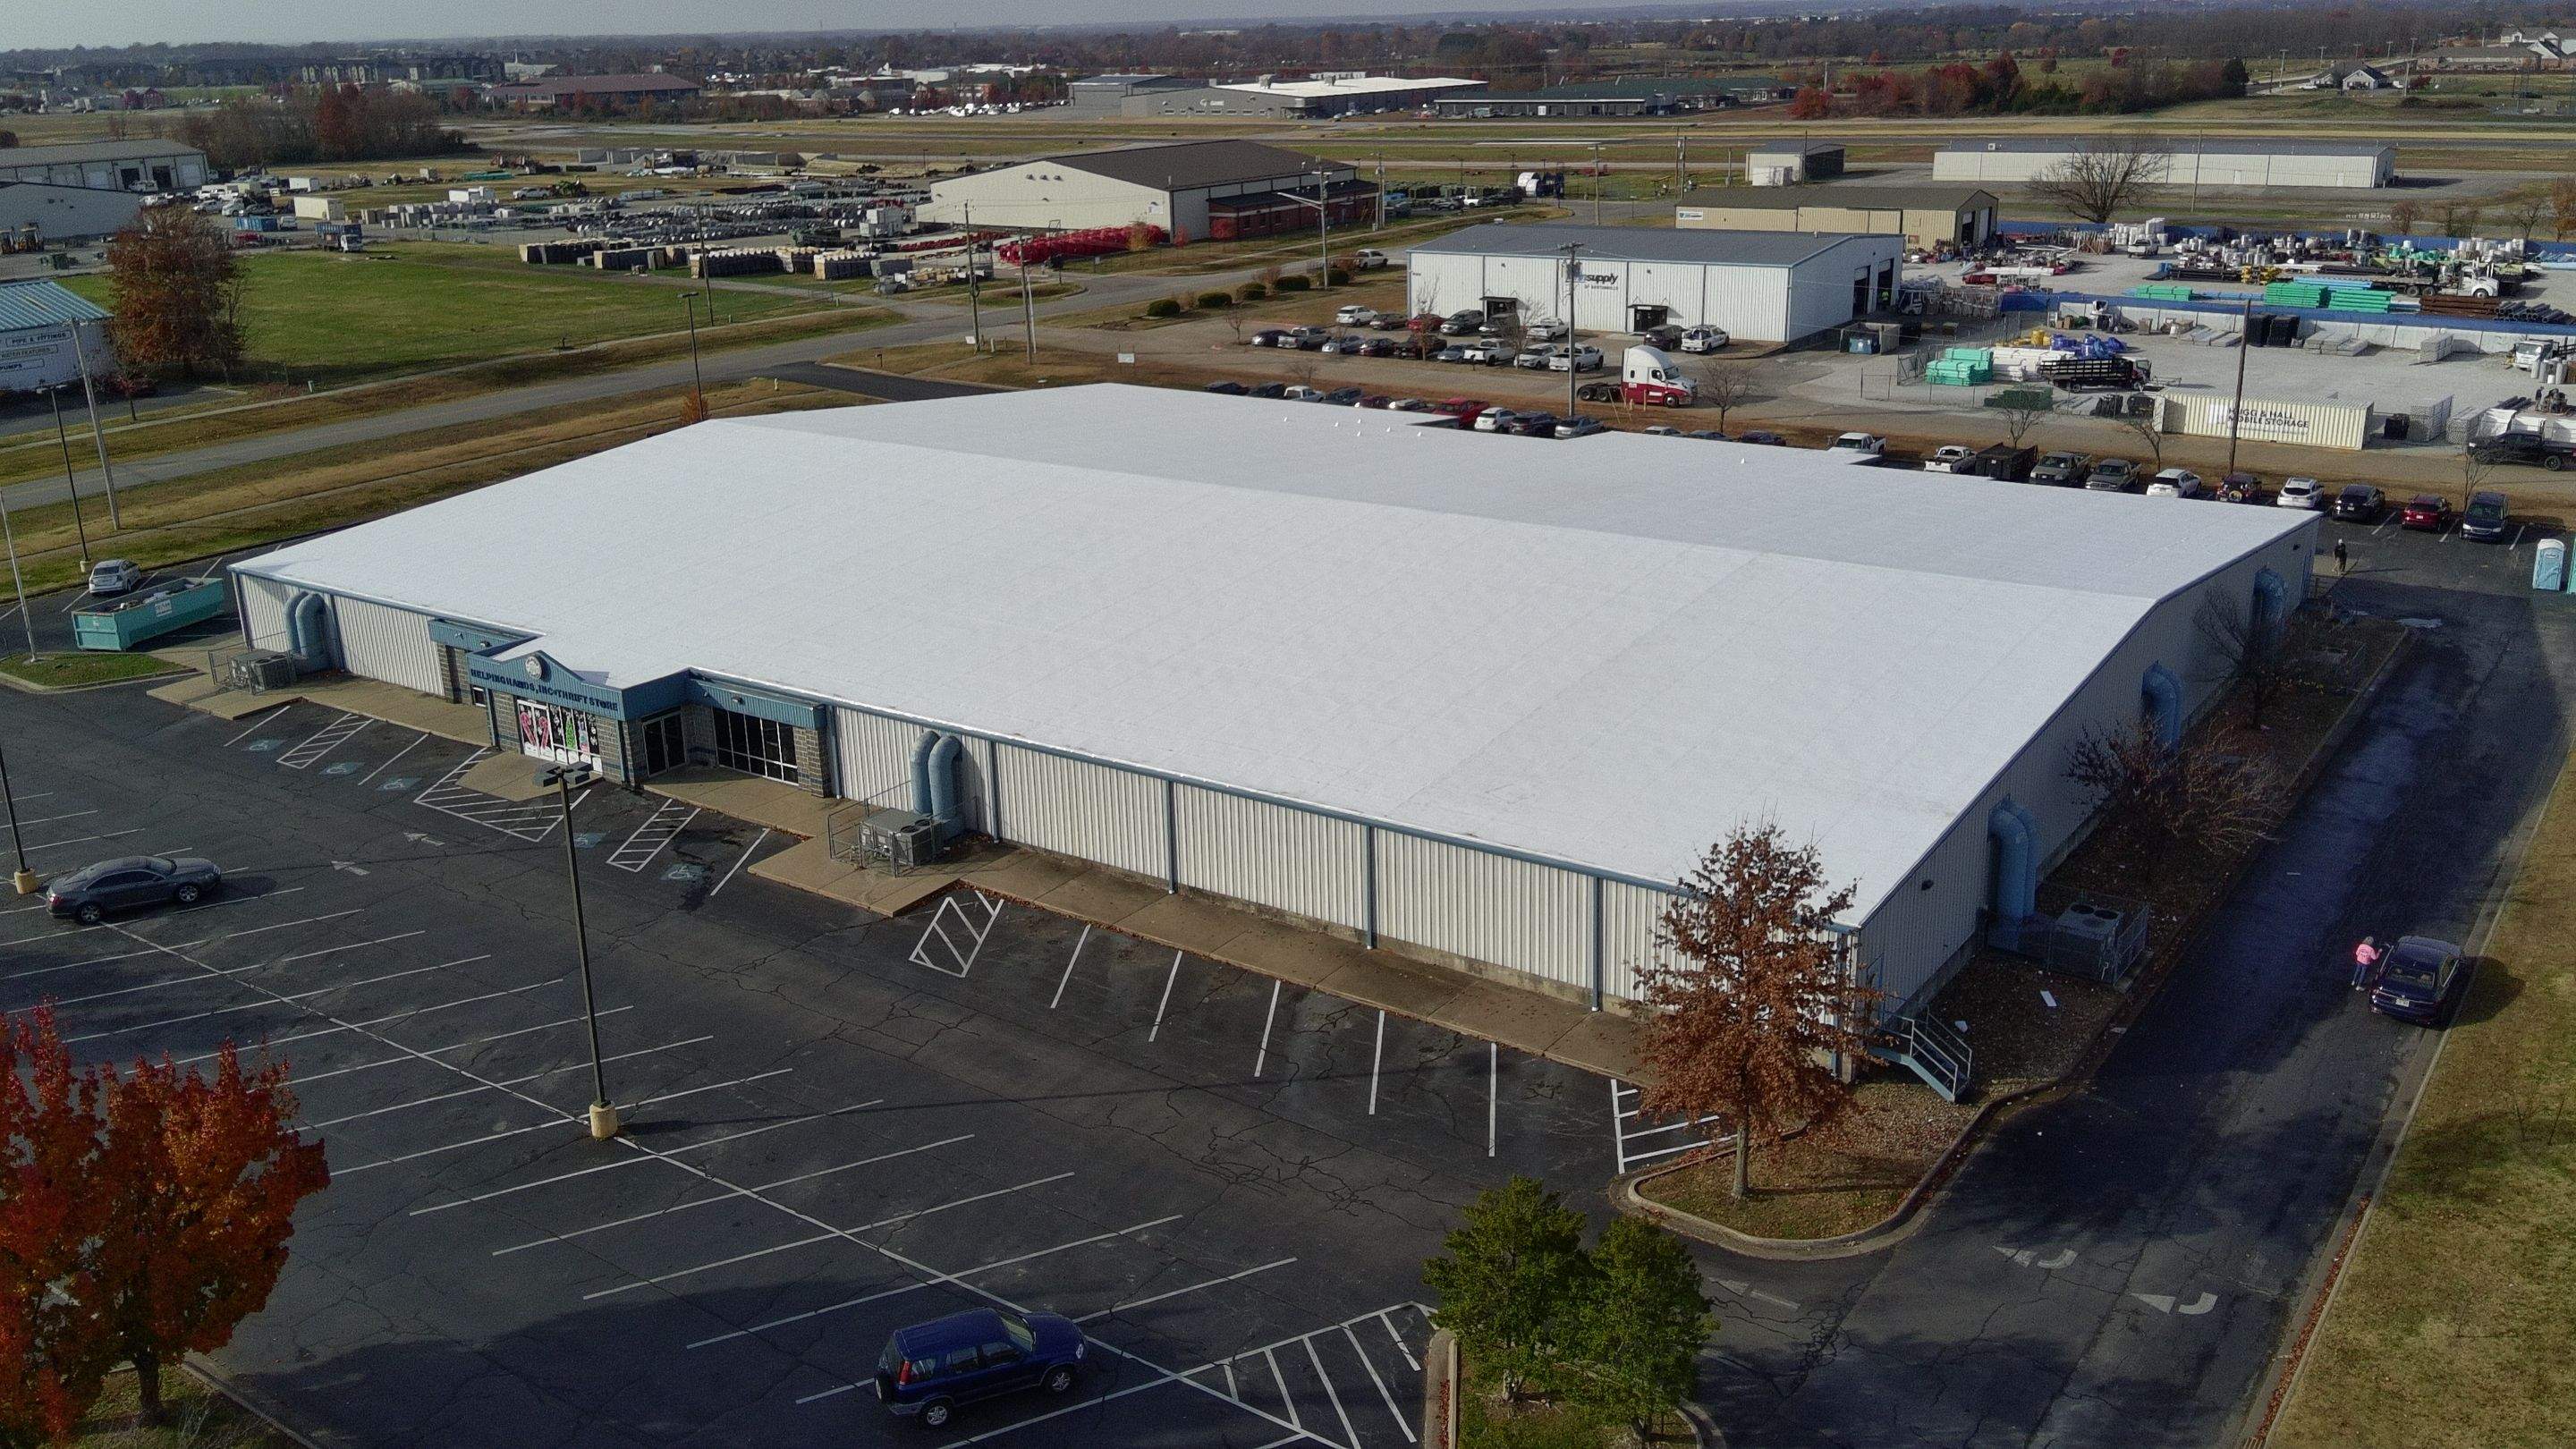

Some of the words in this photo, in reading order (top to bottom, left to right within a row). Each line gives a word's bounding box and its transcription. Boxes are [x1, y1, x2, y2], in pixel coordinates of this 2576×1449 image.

[2269, 411, 2294, 419] HALL
[2265, 418, 2309, 428] STORAGE
[470, 668, 505, 685] HELPING
[589, 697, 619, 712] STORE
